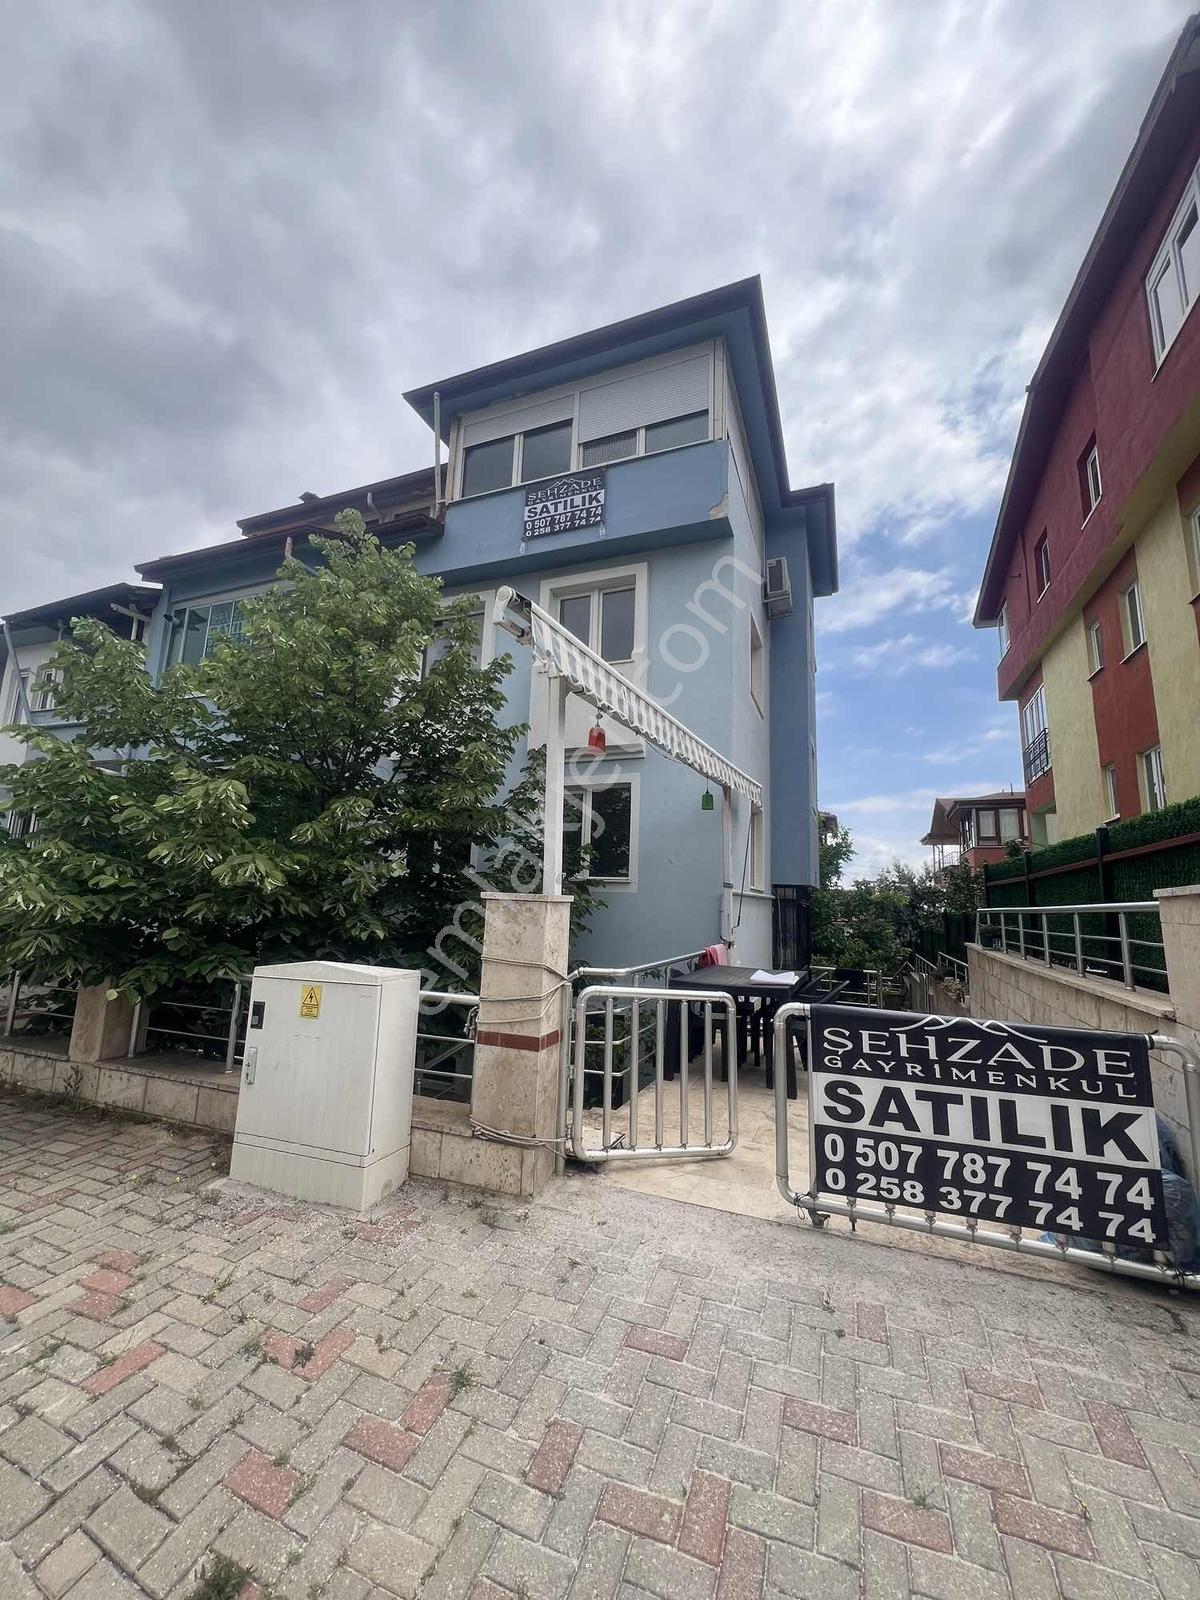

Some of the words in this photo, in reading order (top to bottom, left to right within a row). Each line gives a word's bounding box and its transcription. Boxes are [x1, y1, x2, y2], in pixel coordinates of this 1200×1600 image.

[526, 521, 532, 530] 0
[534, 517, 551, 529] 507
[554, 513, 572, 524] 787
[575, 509, 587, 519] 74
[590, 506, 602, 517] 74
[527, 492, 602, 519] SATILIK
[534, 527, 551, 536] 258
[554, 522, 571, 532] 377
[575, 519, 586, 527] 74
[823, 1027, 1135, 1078] ŞEHZADE
[824, 1080, 1149, 1162] SATILIK
[824, 1133, 845, 1162] 0
[855, 1137, 923, 1174] 507
[937, 1149, 1011, 1188] 787
[1026, 1161, 1083, 1200] 74
[1096, 1171, 1155, 1211] 74
[825, 1168, 846, 1190] 0
[856, 1173, 925, 1203] 258
[938, 1186, 1013, 1218] 377
[1028, 1200, 1084, 1231] 74
[1098, 1211, 1157, 1243] 74
